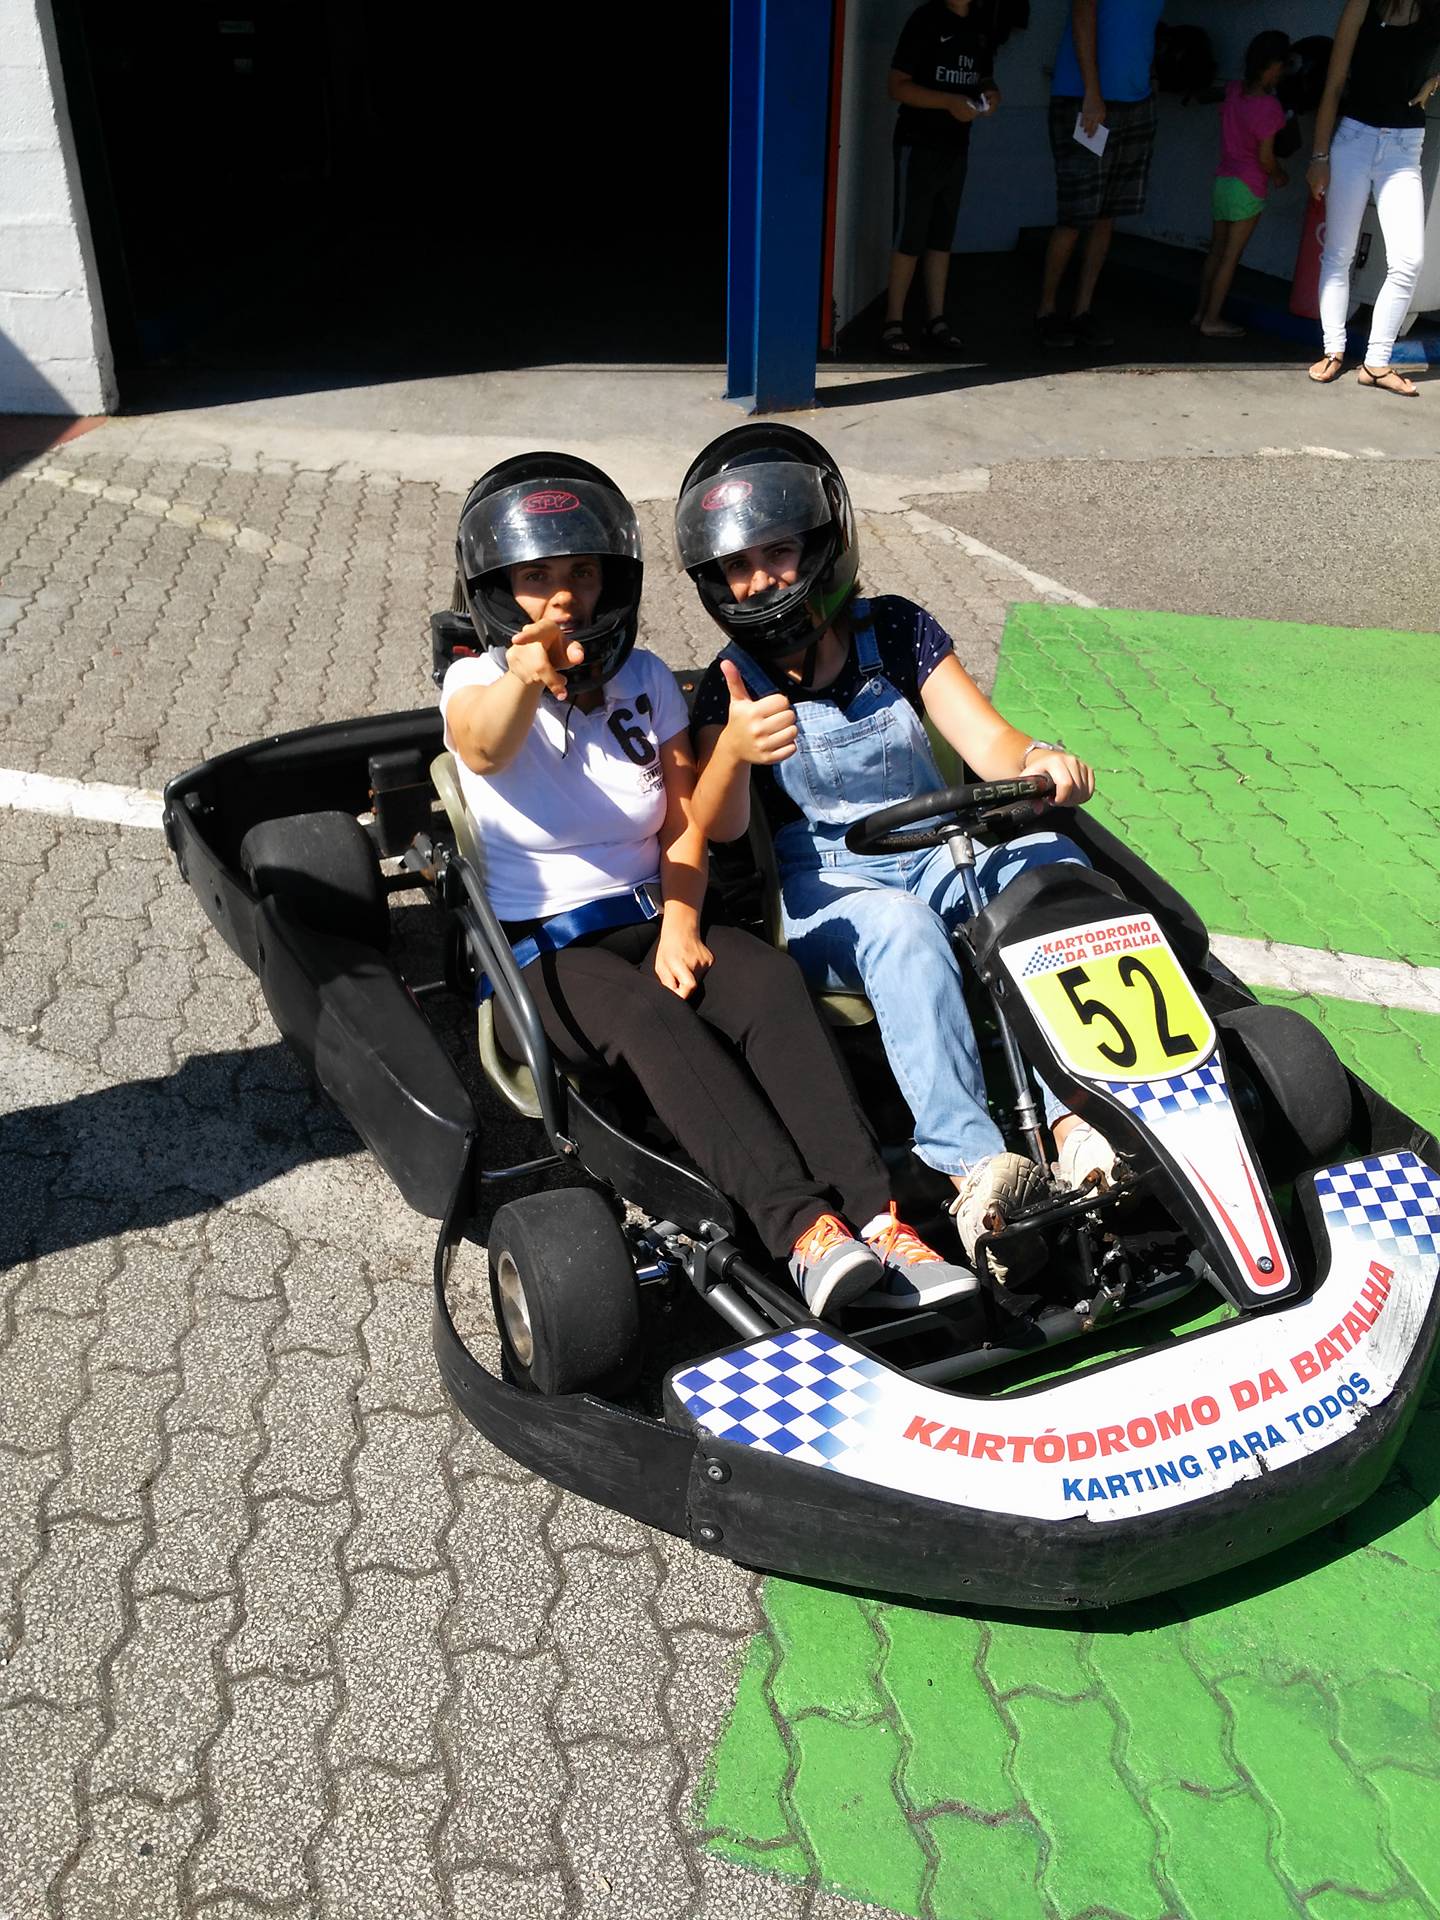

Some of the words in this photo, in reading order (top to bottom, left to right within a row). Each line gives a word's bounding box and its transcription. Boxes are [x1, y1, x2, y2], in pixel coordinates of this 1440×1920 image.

[527, 495, 571, 509] SPY
[1043, 921, 1151, 955] KARTÓDROMO
[1064, 951, 1088, 963] DA
[1093, 933, 1161, 956] BATALHA
[1056, 956, 1199, 1068] 52
[902, 1394, 1221, 1464] KARTÓDROMO
[1229, 1368, 1289, 1412] DA
[1290, 1260, 1396, 1385] BATALHA
[1062, 1453, 1204, 1503] KARTING
[1209, 1424, 1287, 1471] PARA
[1285, 1371, 1372, 1435] TODOS
